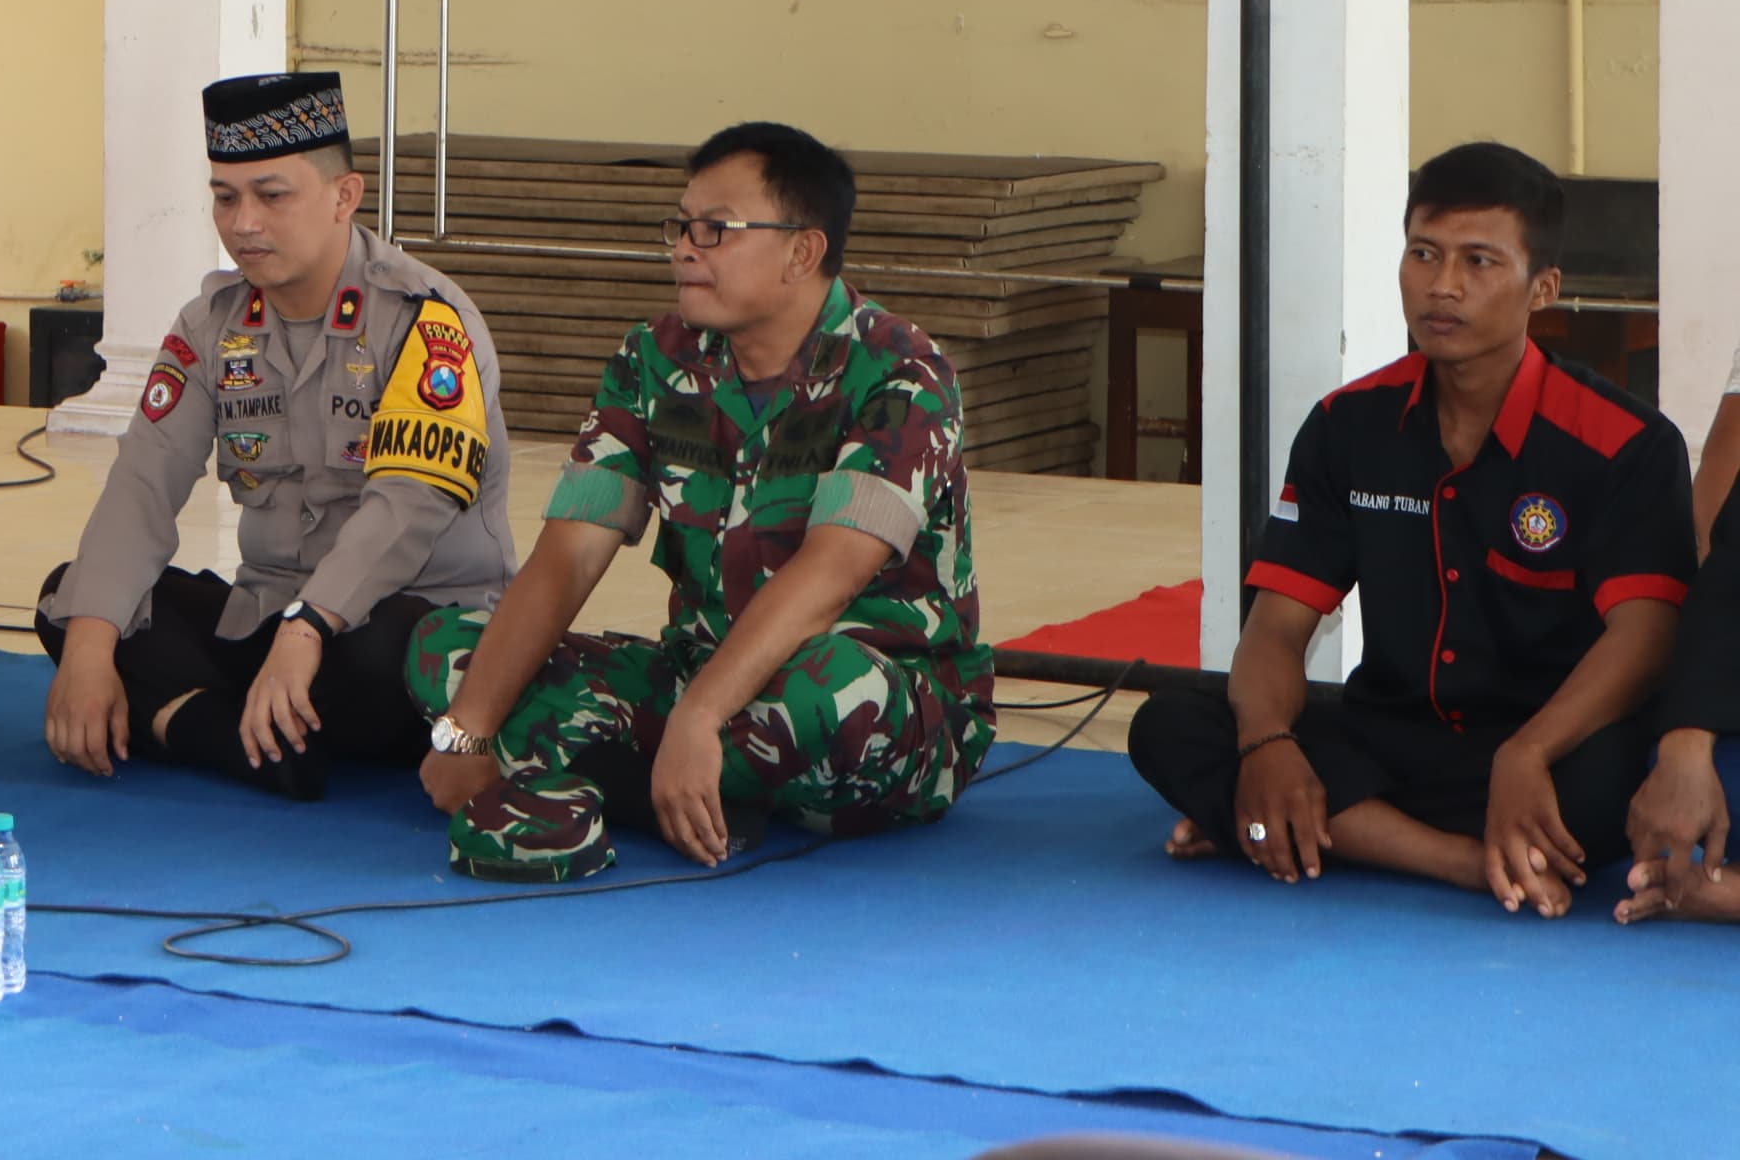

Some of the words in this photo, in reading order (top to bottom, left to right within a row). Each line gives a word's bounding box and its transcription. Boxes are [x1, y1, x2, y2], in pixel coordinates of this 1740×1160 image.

[370, 419, 465, 469] WAKAOPS
[1349, 490, 1390, 511] CABANG
[1394, 495, 1430, 515] TUBAN
